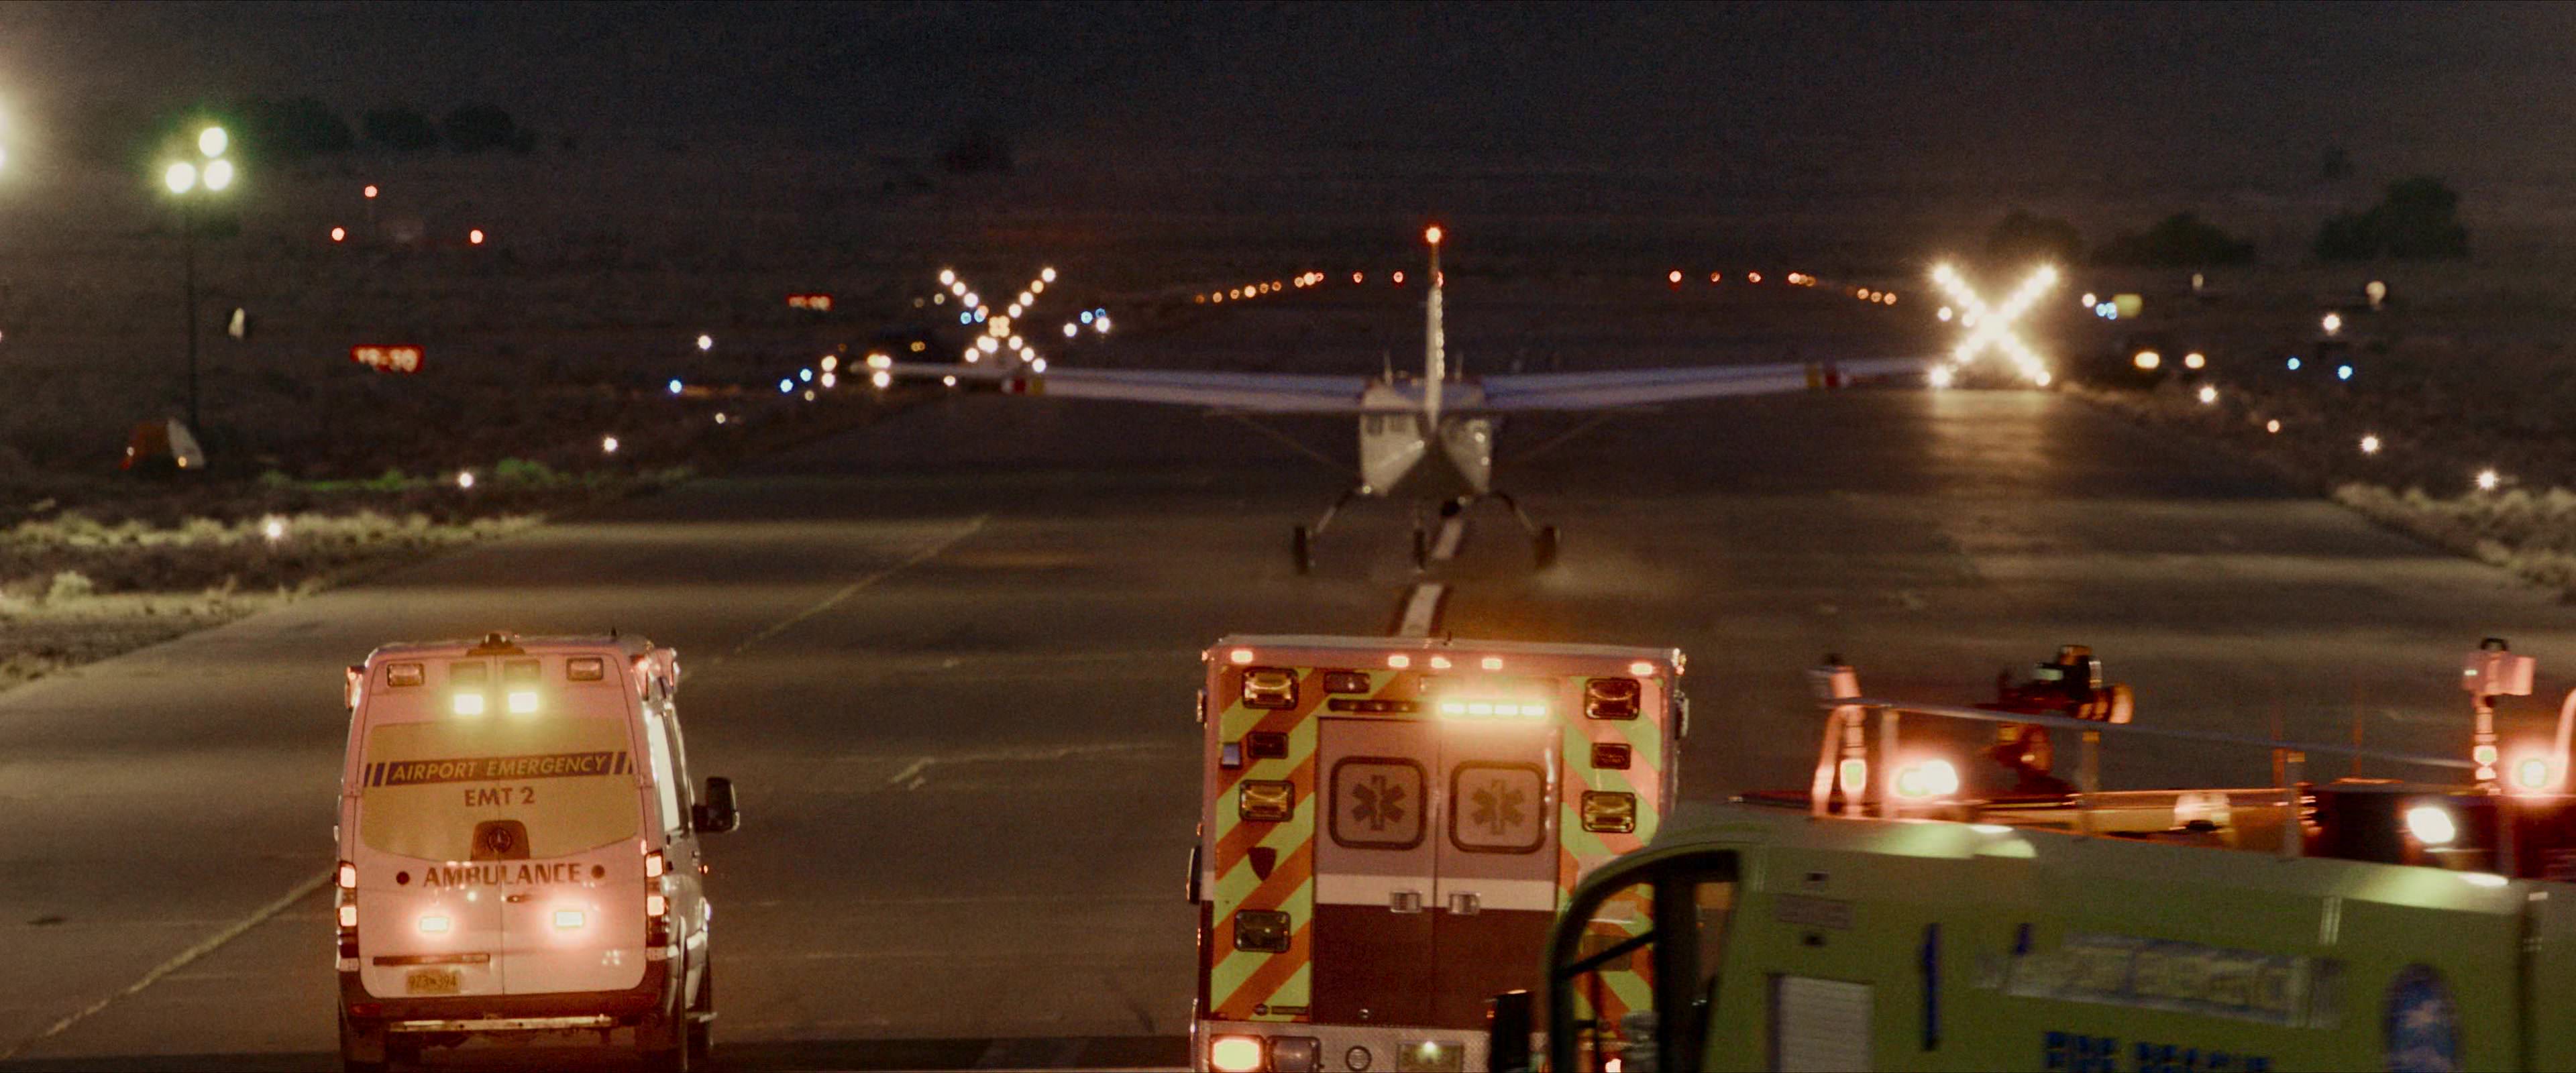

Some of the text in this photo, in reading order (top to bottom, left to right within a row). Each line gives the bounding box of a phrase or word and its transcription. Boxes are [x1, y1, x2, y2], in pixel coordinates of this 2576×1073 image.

[392, 755, 607, 781] AIRPORT EMERGENCY
[464, 785, 535, 807] EMT 2
[423, 862, 582, 888] AMBULANCE
